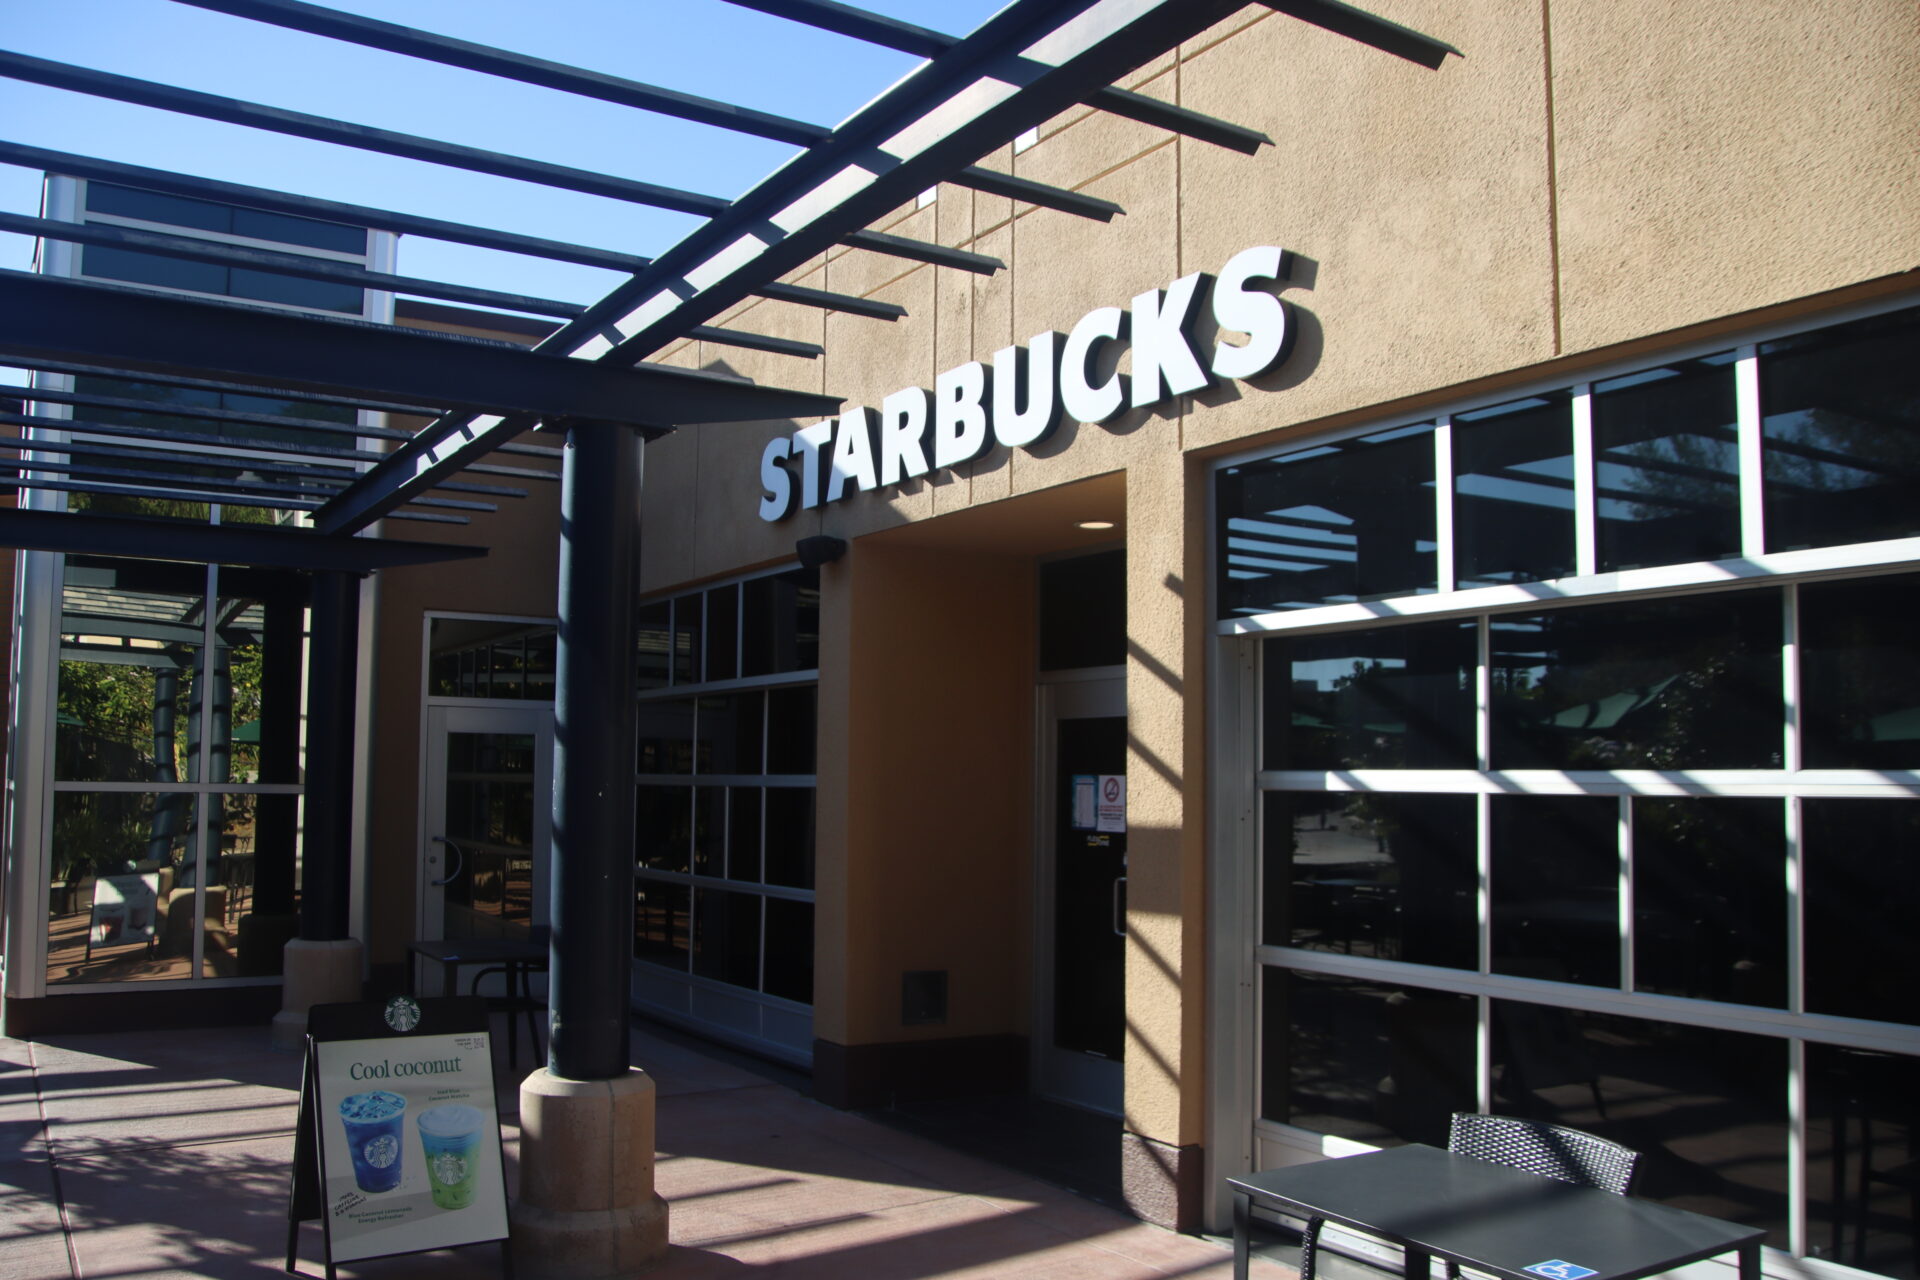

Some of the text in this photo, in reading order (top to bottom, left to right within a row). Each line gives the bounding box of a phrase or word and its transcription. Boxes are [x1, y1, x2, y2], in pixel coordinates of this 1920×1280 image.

[758, 245, 1292, 522] STARBUCKS
[350, 1056, 463, 1081] Cool coconut
